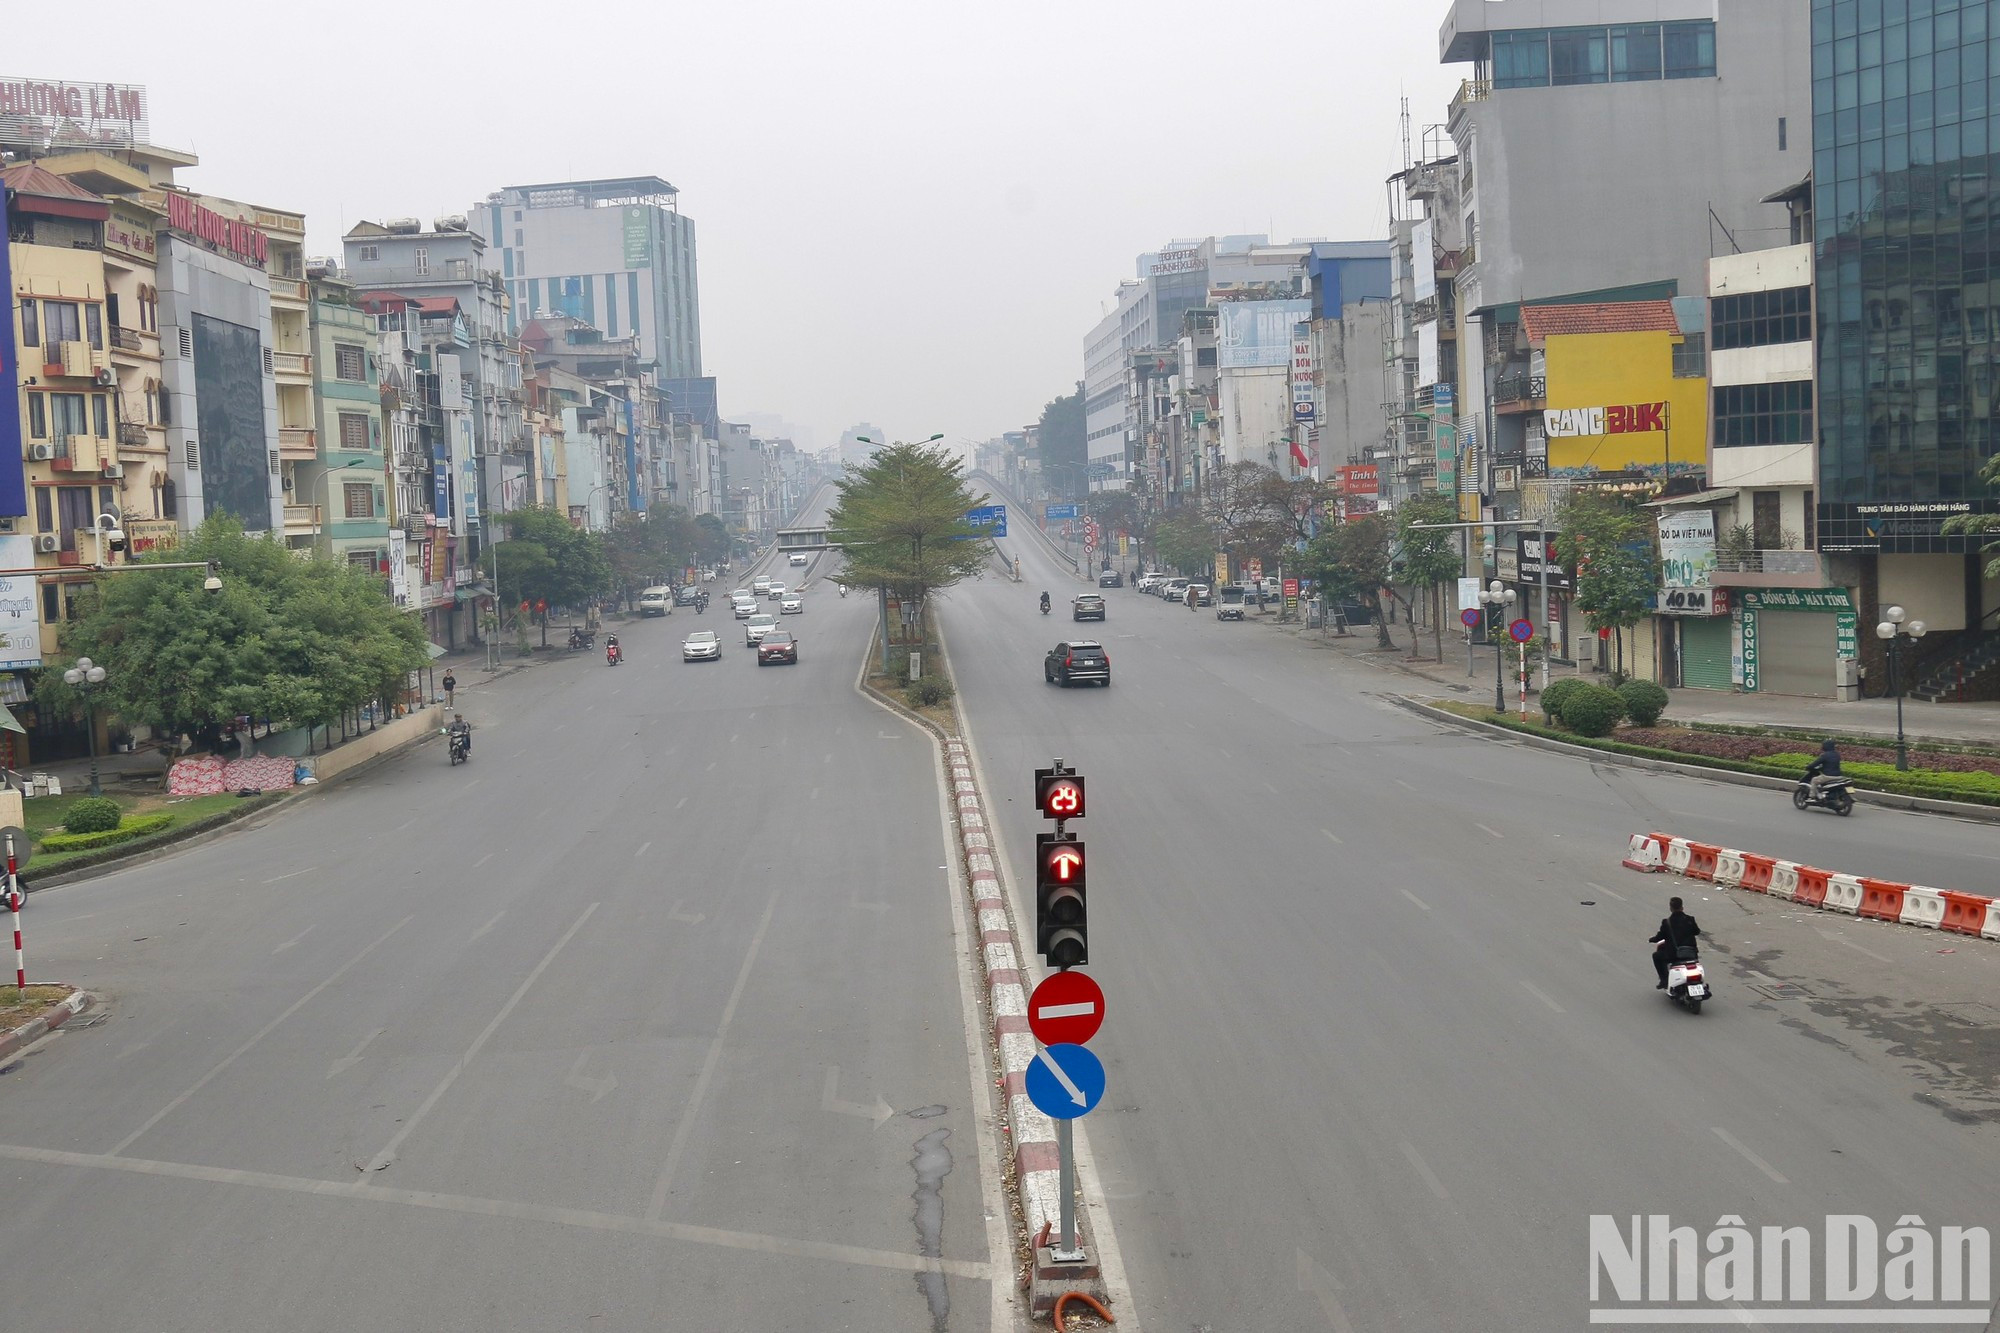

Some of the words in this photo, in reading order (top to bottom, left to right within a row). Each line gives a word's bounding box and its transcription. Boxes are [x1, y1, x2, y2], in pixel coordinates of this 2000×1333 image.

[89, 83, 141, 120] LÂM
[196, 204, 227, 247] KHOA
[254, 221, 268, 263] ÚC
[1295, 342, 1309, 354] MÁY
[1294, 369, 1313, 381] NƯỚC
[1608, 403, 1664, 433] BUK
[1909, 504, 1928, 512] HÀNH
[1950, 503, 1970, 511] HÃNG
[1672, 530, 1680, 538] DA
[1698, 529, 1713, 538] NAM
[1666, 590, 1685, 607] ÁO
[1687, 592, 1705, 607] DA
[1761, 589, 1785, 604] ĐỒNG
[1786, 589, 1800, 605] HỒ
[1804, 592, 1825, 606] MÁY
[1825, 592, 1849, 606] TÍNH
[1715, 604, 1727, 613] DA
[16, 635, 33, 649] TÔ
